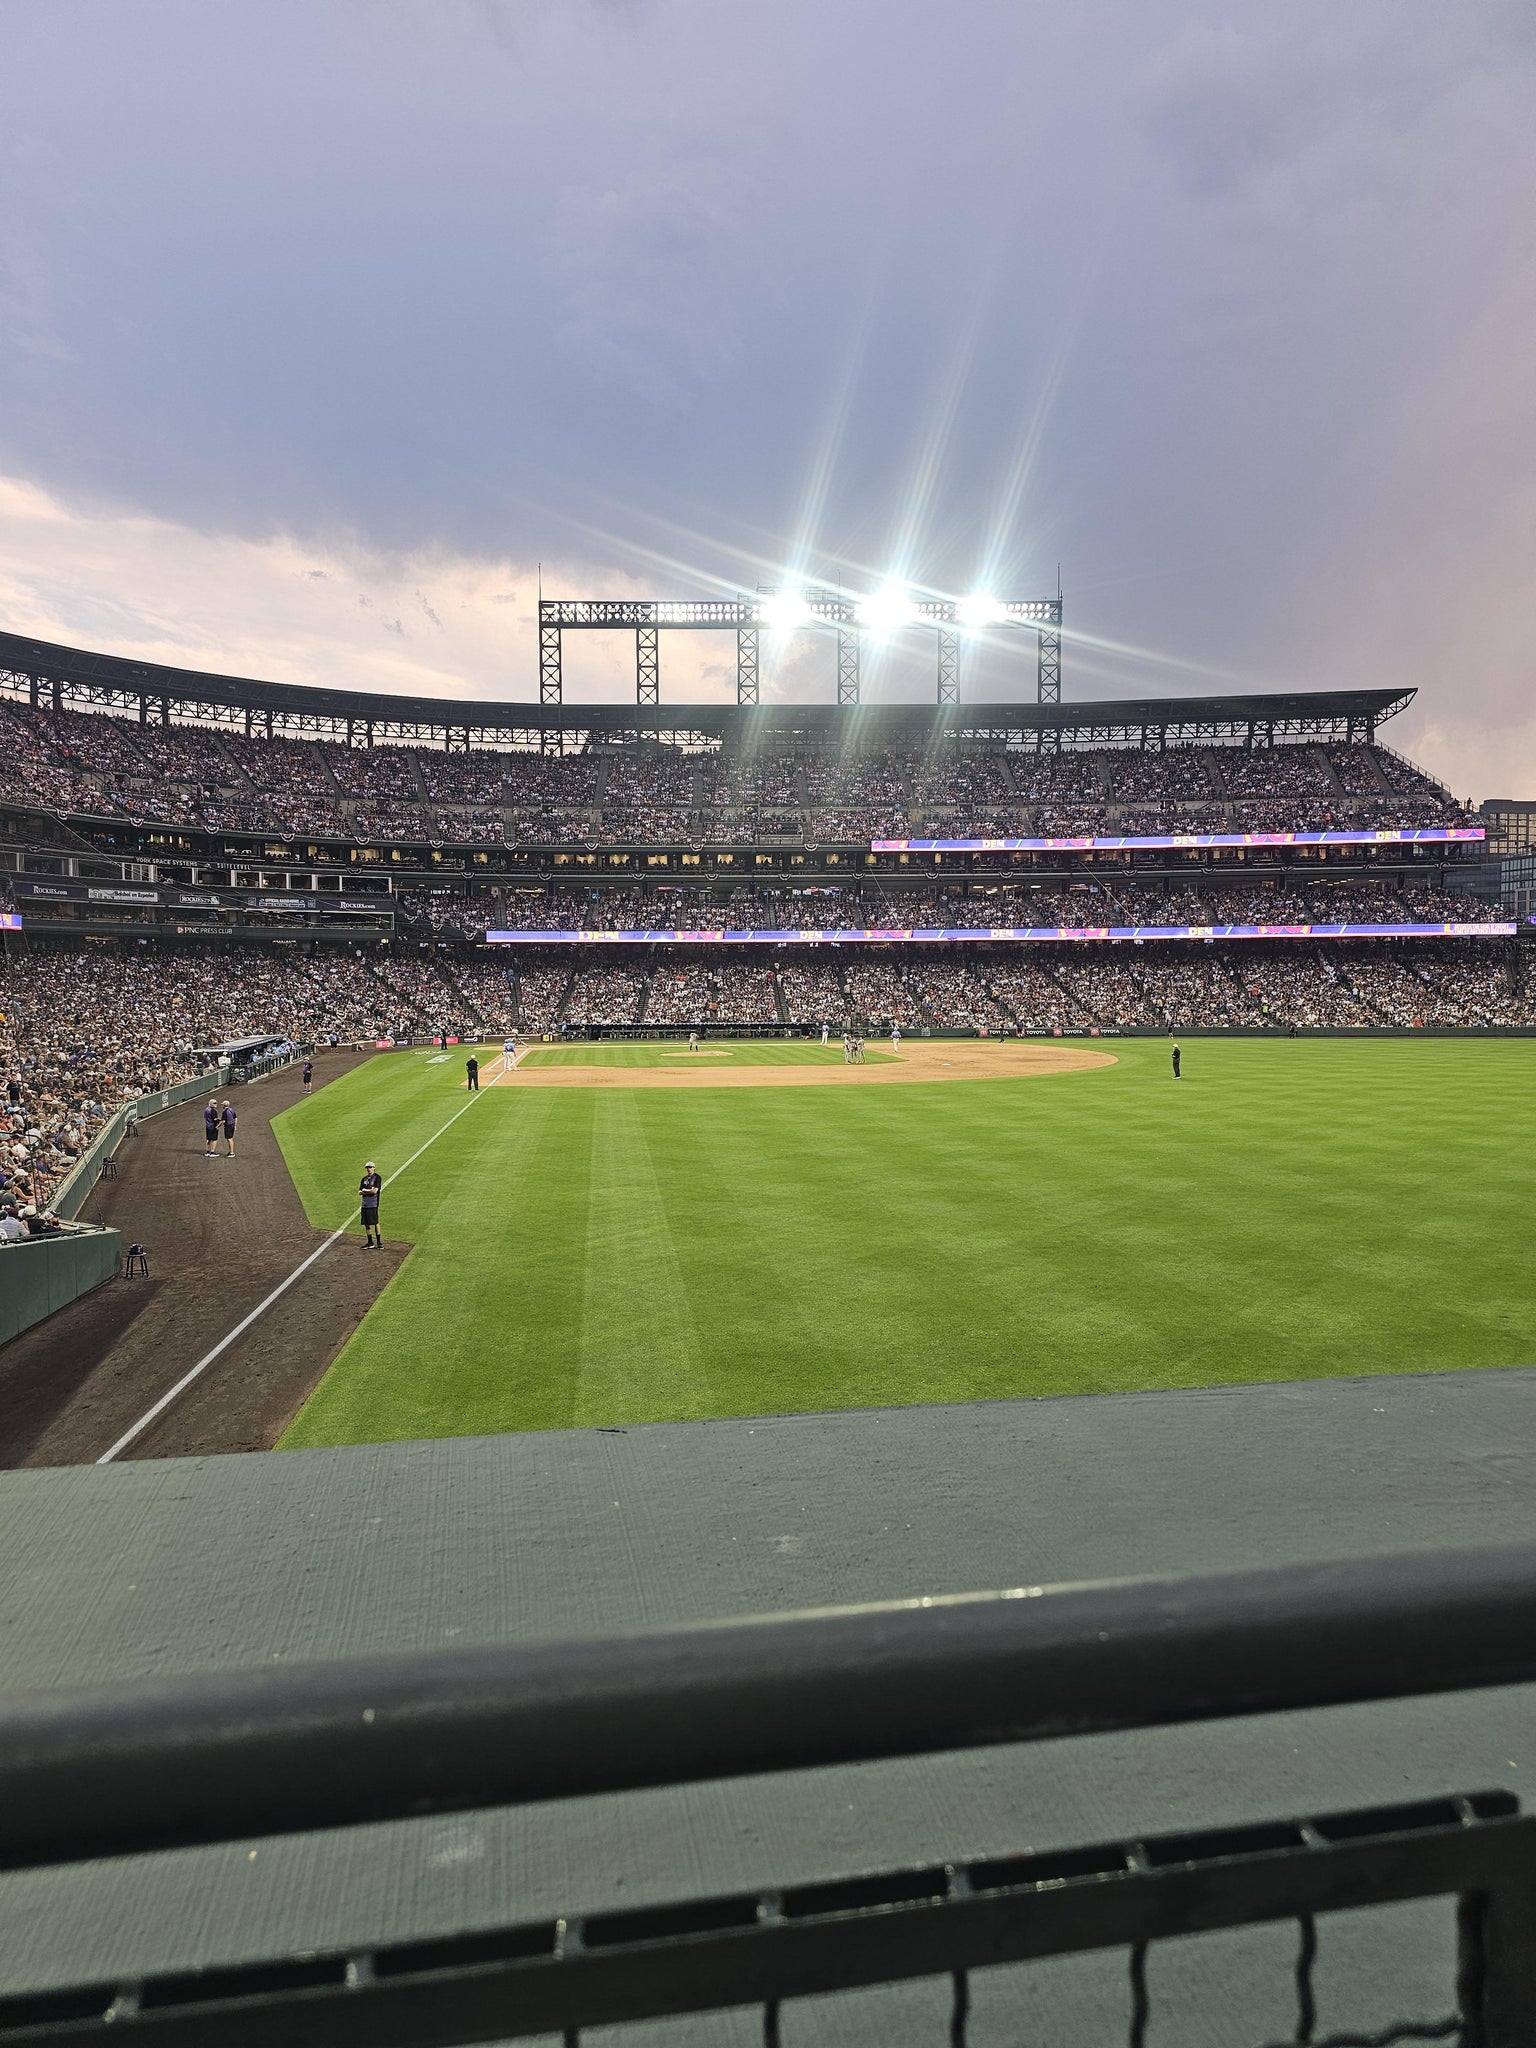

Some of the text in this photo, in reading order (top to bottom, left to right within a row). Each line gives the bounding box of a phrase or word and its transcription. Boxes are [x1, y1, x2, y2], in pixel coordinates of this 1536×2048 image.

[982, 840, 1005, 848] DEN
[1173, 836, 1197, 845] DEN
[173, 859, 198, 867] SYSTEMS
[184, 926, 200, 934] PNC
[990, 929, 1014, 938] DEN
[1188, 927, 1213, 936] DEN
[800, 931, 823, 940] DEN
